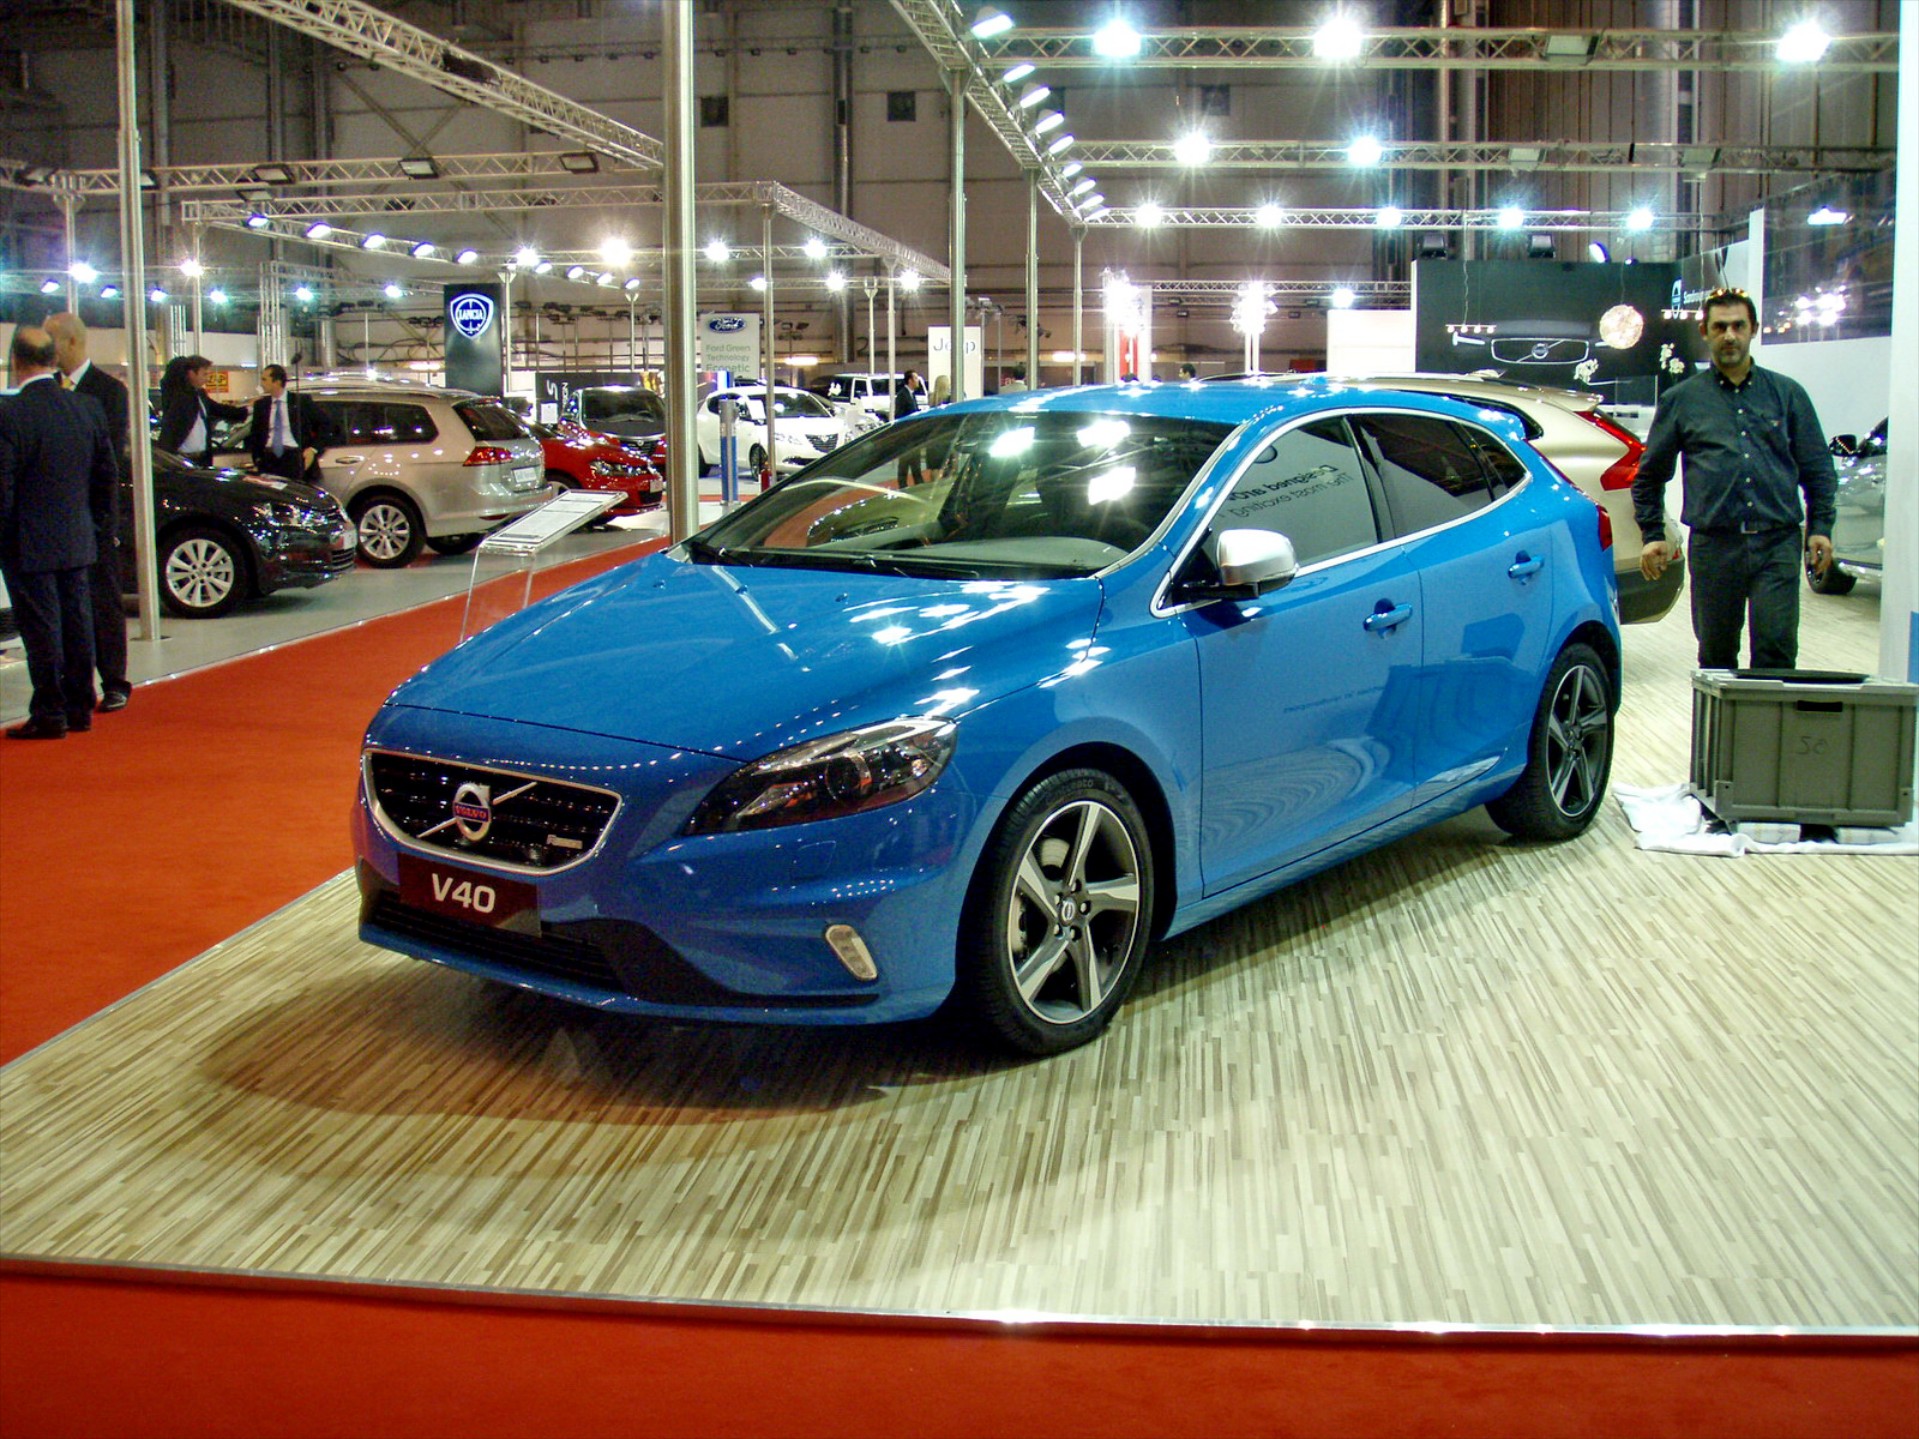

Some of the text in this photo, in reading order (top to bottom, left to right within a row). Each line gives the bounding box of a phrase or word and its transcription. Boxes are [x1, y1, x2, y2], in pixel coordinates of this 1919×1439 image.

[706, 344, 751, 352] Ford Green
[933, 338, 976, 354] Jep
[706, 353, 750, 362] Technology
[455, 805, 487, 819] VOLVO
[431, 872, 496, 914] V40
